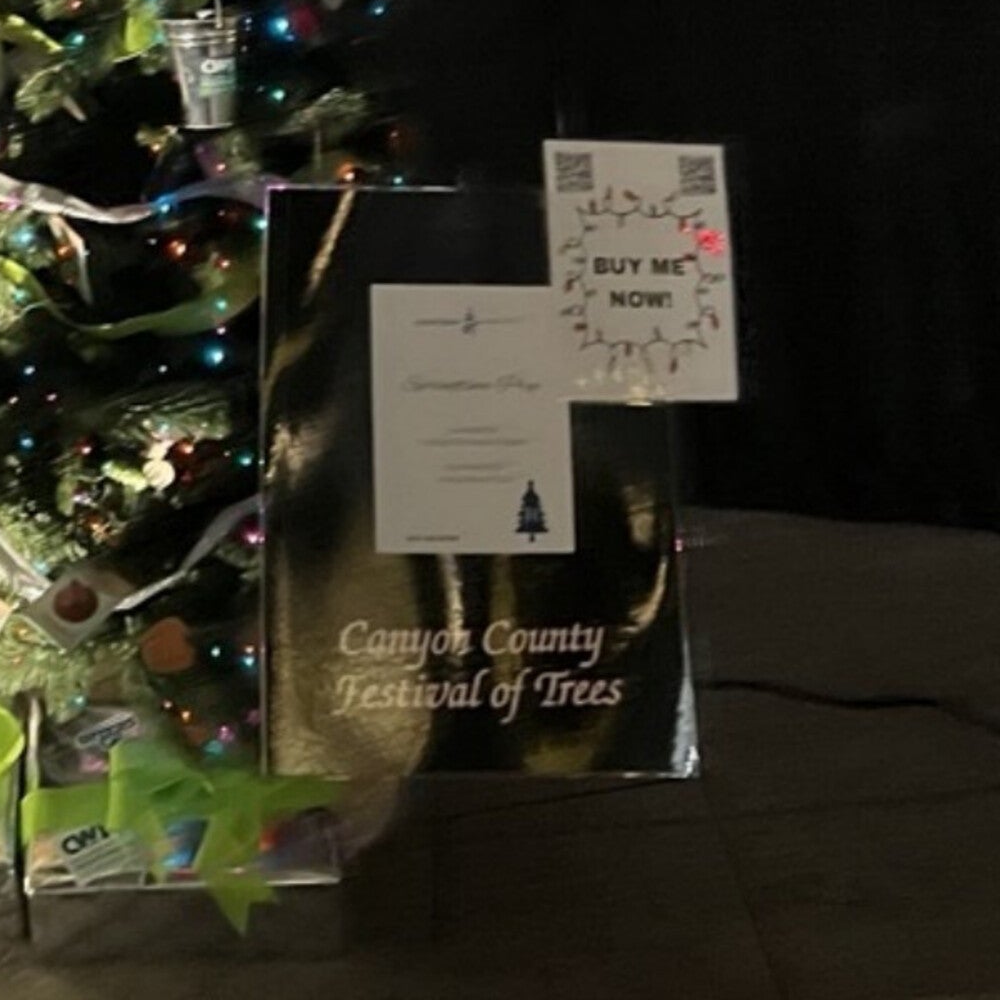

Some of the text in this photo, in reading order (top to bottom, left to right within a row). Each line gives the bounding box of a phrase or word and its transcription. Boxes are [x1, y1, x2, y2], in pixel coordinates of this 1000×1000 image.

[593, 256, 685, 276] BUY ME
[339, 618, 604, 671] Canyon County
[330, 667, 624, 724] Festival of Trees
